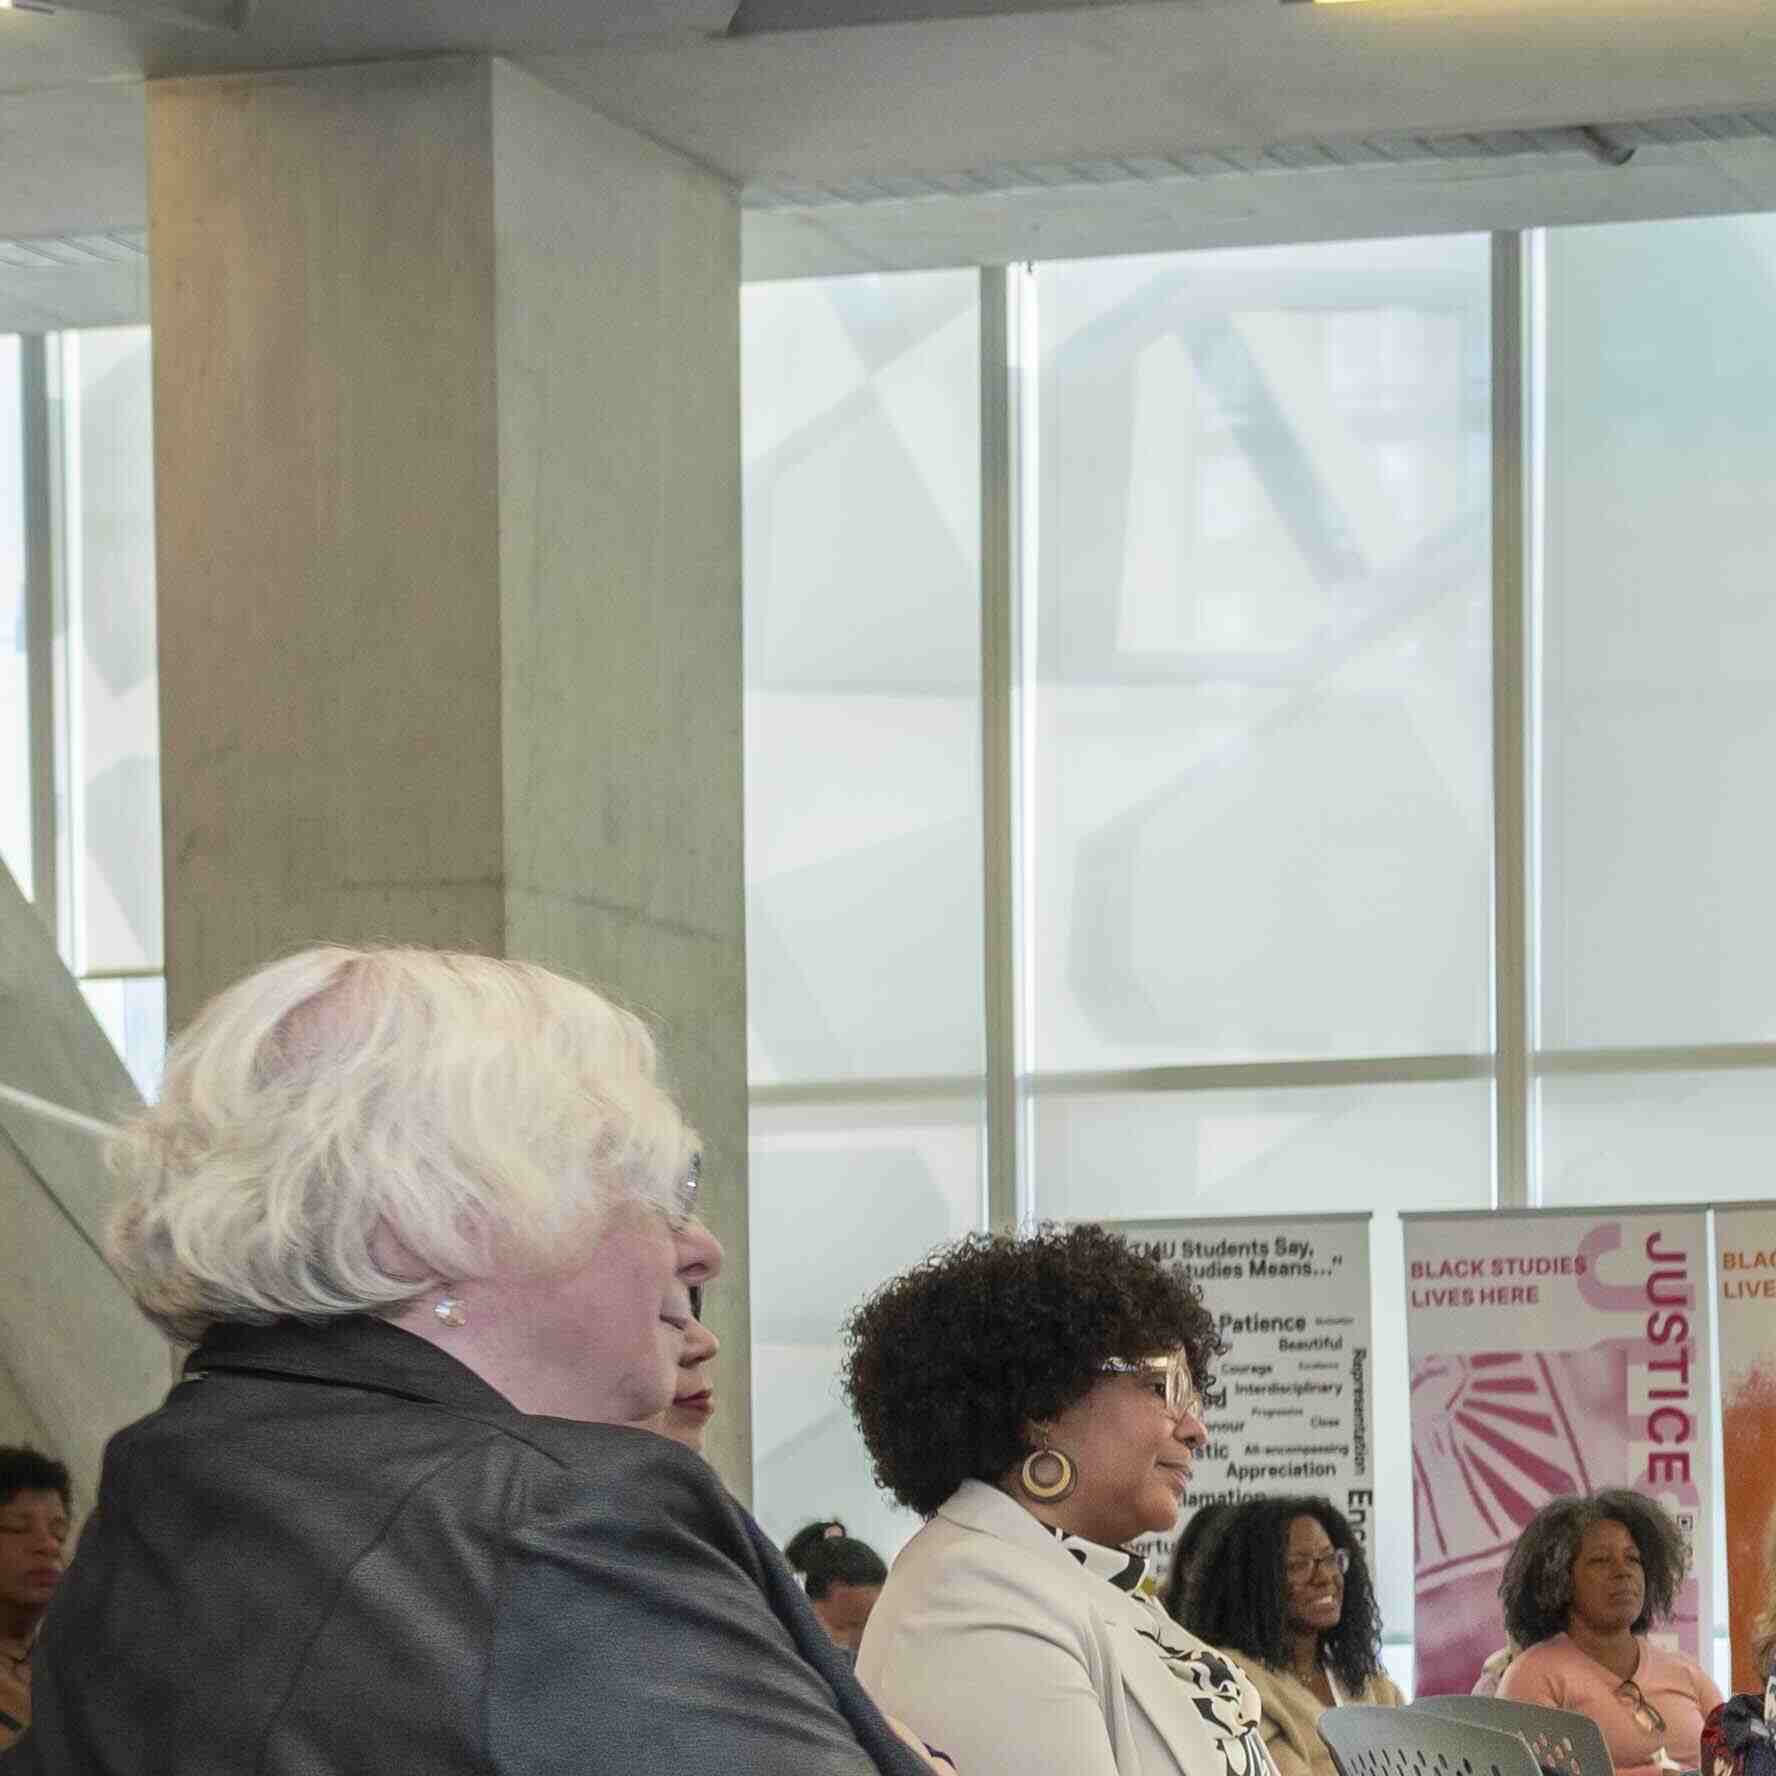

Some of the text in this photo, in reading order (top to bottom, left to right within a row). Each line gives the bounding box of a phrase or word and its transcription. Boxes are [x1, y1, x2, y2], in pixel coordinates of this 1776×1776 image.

[1182, 1240, 1268, 1259] Students
[1184, 1262, 1243, 1280] tudies
[1411, 1254, 1588, 1279] BLACK STUDIES
[1412, 1285, 1539, 1308] LIVES HERE
[1219, 1313, 1307, 1333] Patience
[1279, 1337, 1344, 1352] Beautiful
[1646, 1232, 1692, 1484] JUSTICE
[1221, 1363, 1273, 1376] Courage
[1235, 1382, 1343, 1397] Interdisciplinary
[1204, 1421, 1245, 1433] onour
[1226, 1462, 1336, 1482] Appreciation
